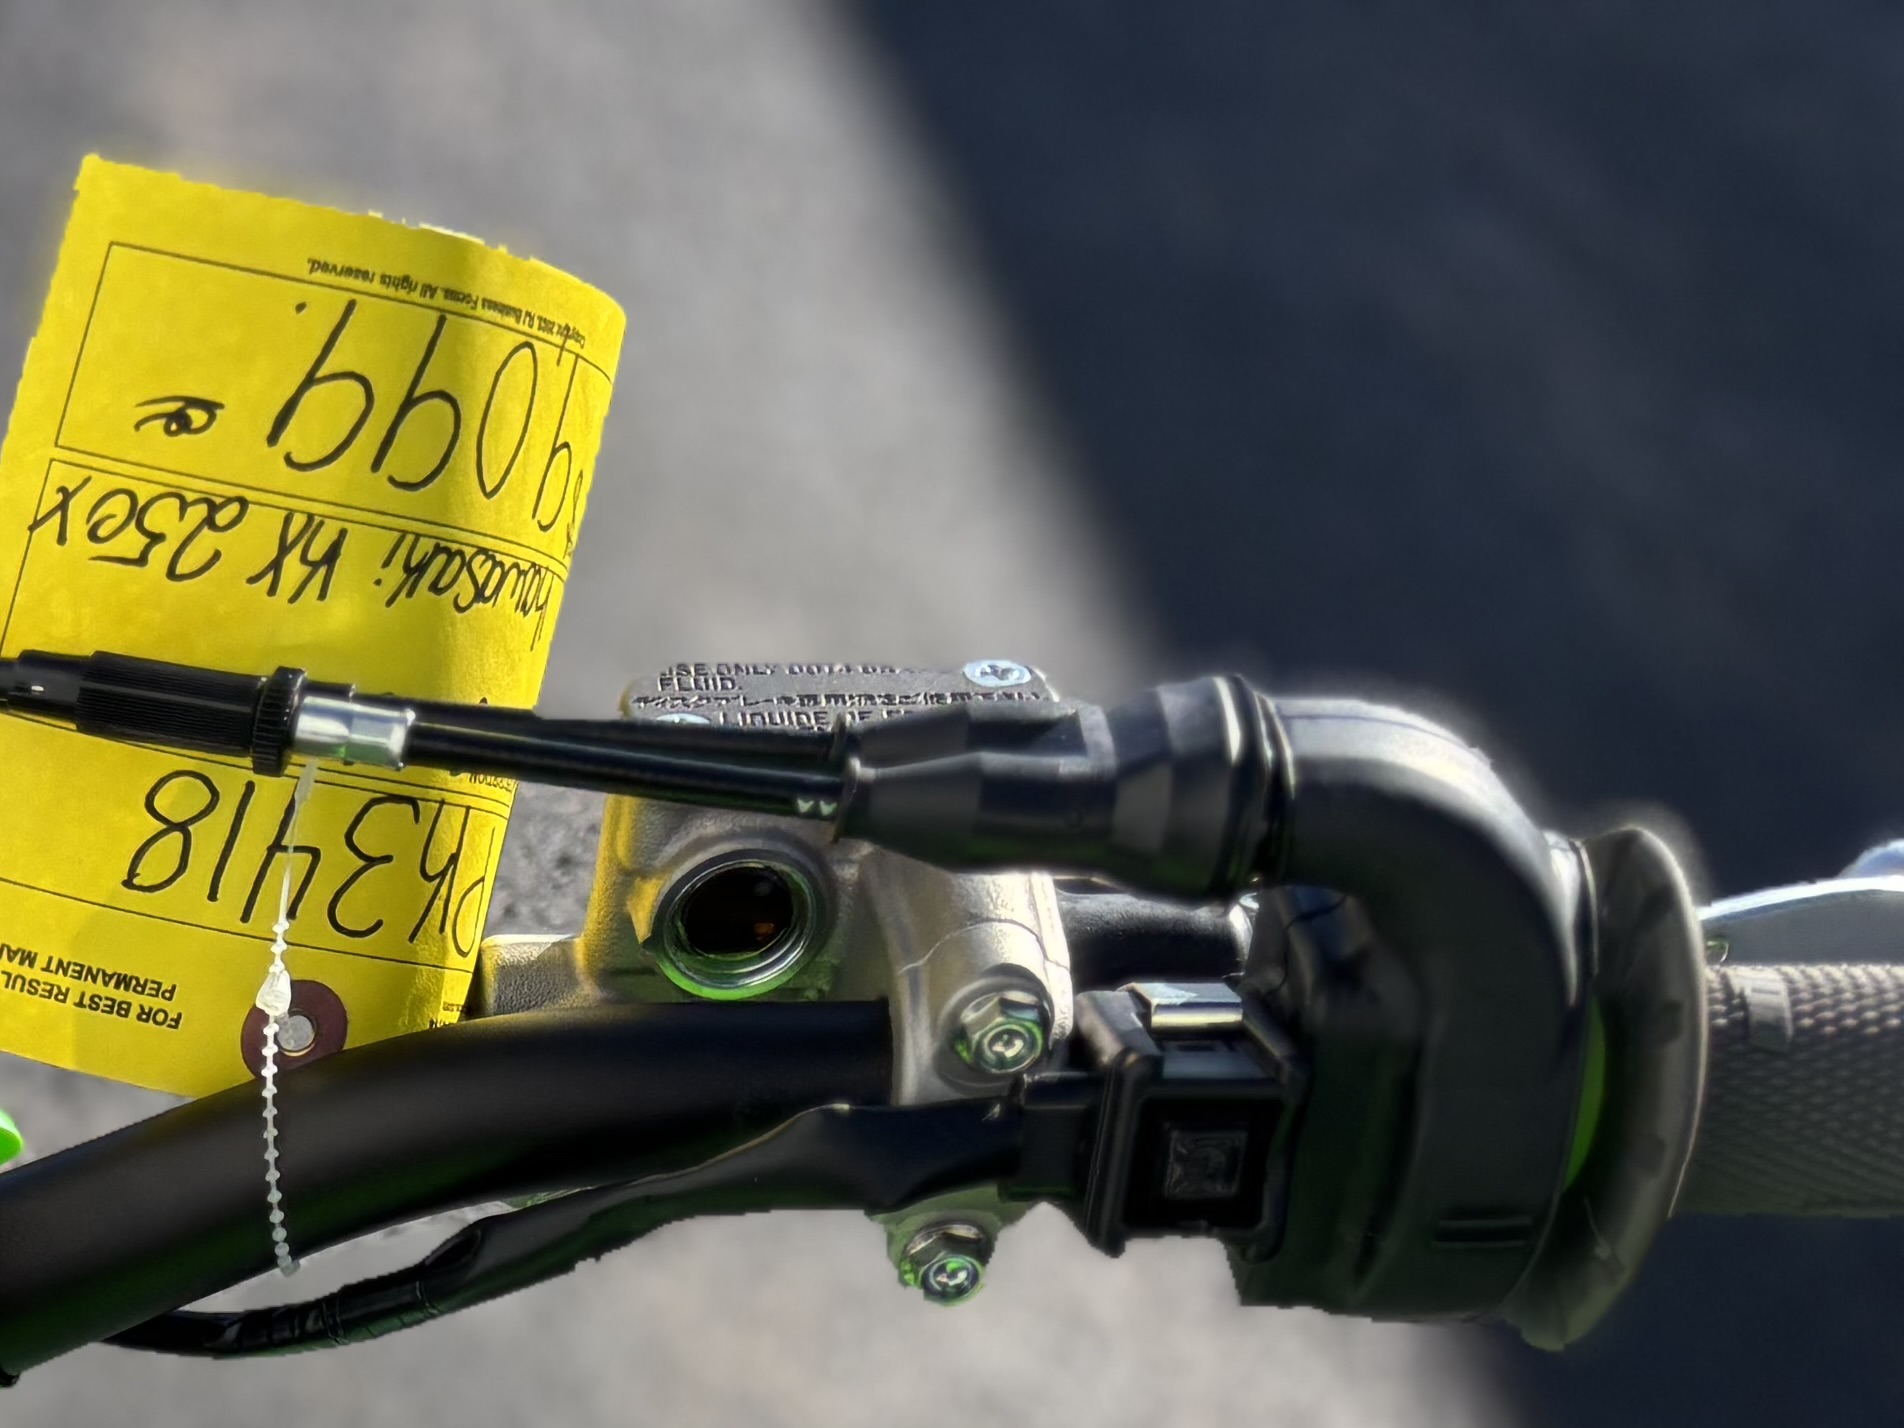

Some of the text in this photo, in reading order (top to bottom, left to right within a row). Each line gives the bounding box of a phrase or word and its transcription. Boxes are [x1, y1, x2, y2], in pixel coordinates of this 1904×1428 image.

[306, 258, 376, 283] reserved.
[379, 274, 418, 294] rights
[420, 283, 438, 300] All
[40, 956, 177, 1002] PERMANENT
[72, 990, 132, 1020] BEST
[136, 1004, 182, 1030] FOR
